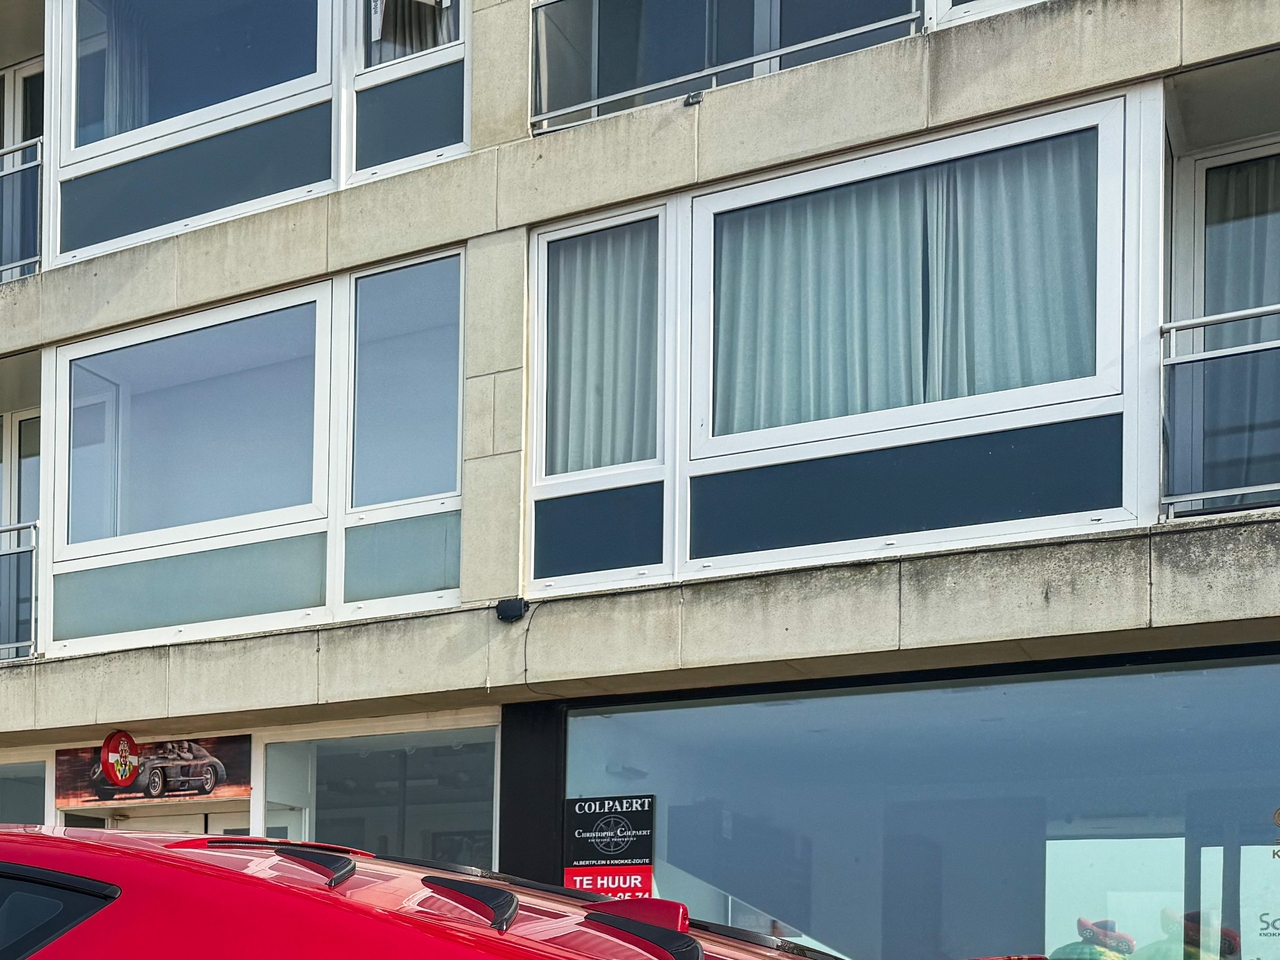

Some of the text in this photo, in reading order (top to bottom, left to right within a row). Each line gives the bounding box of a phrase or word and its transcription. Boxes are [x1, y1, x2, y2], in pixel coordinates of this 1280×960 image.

[575, 798, 651, 814] COLPAERT
[573, 875, 642, 889] TE HUUR
